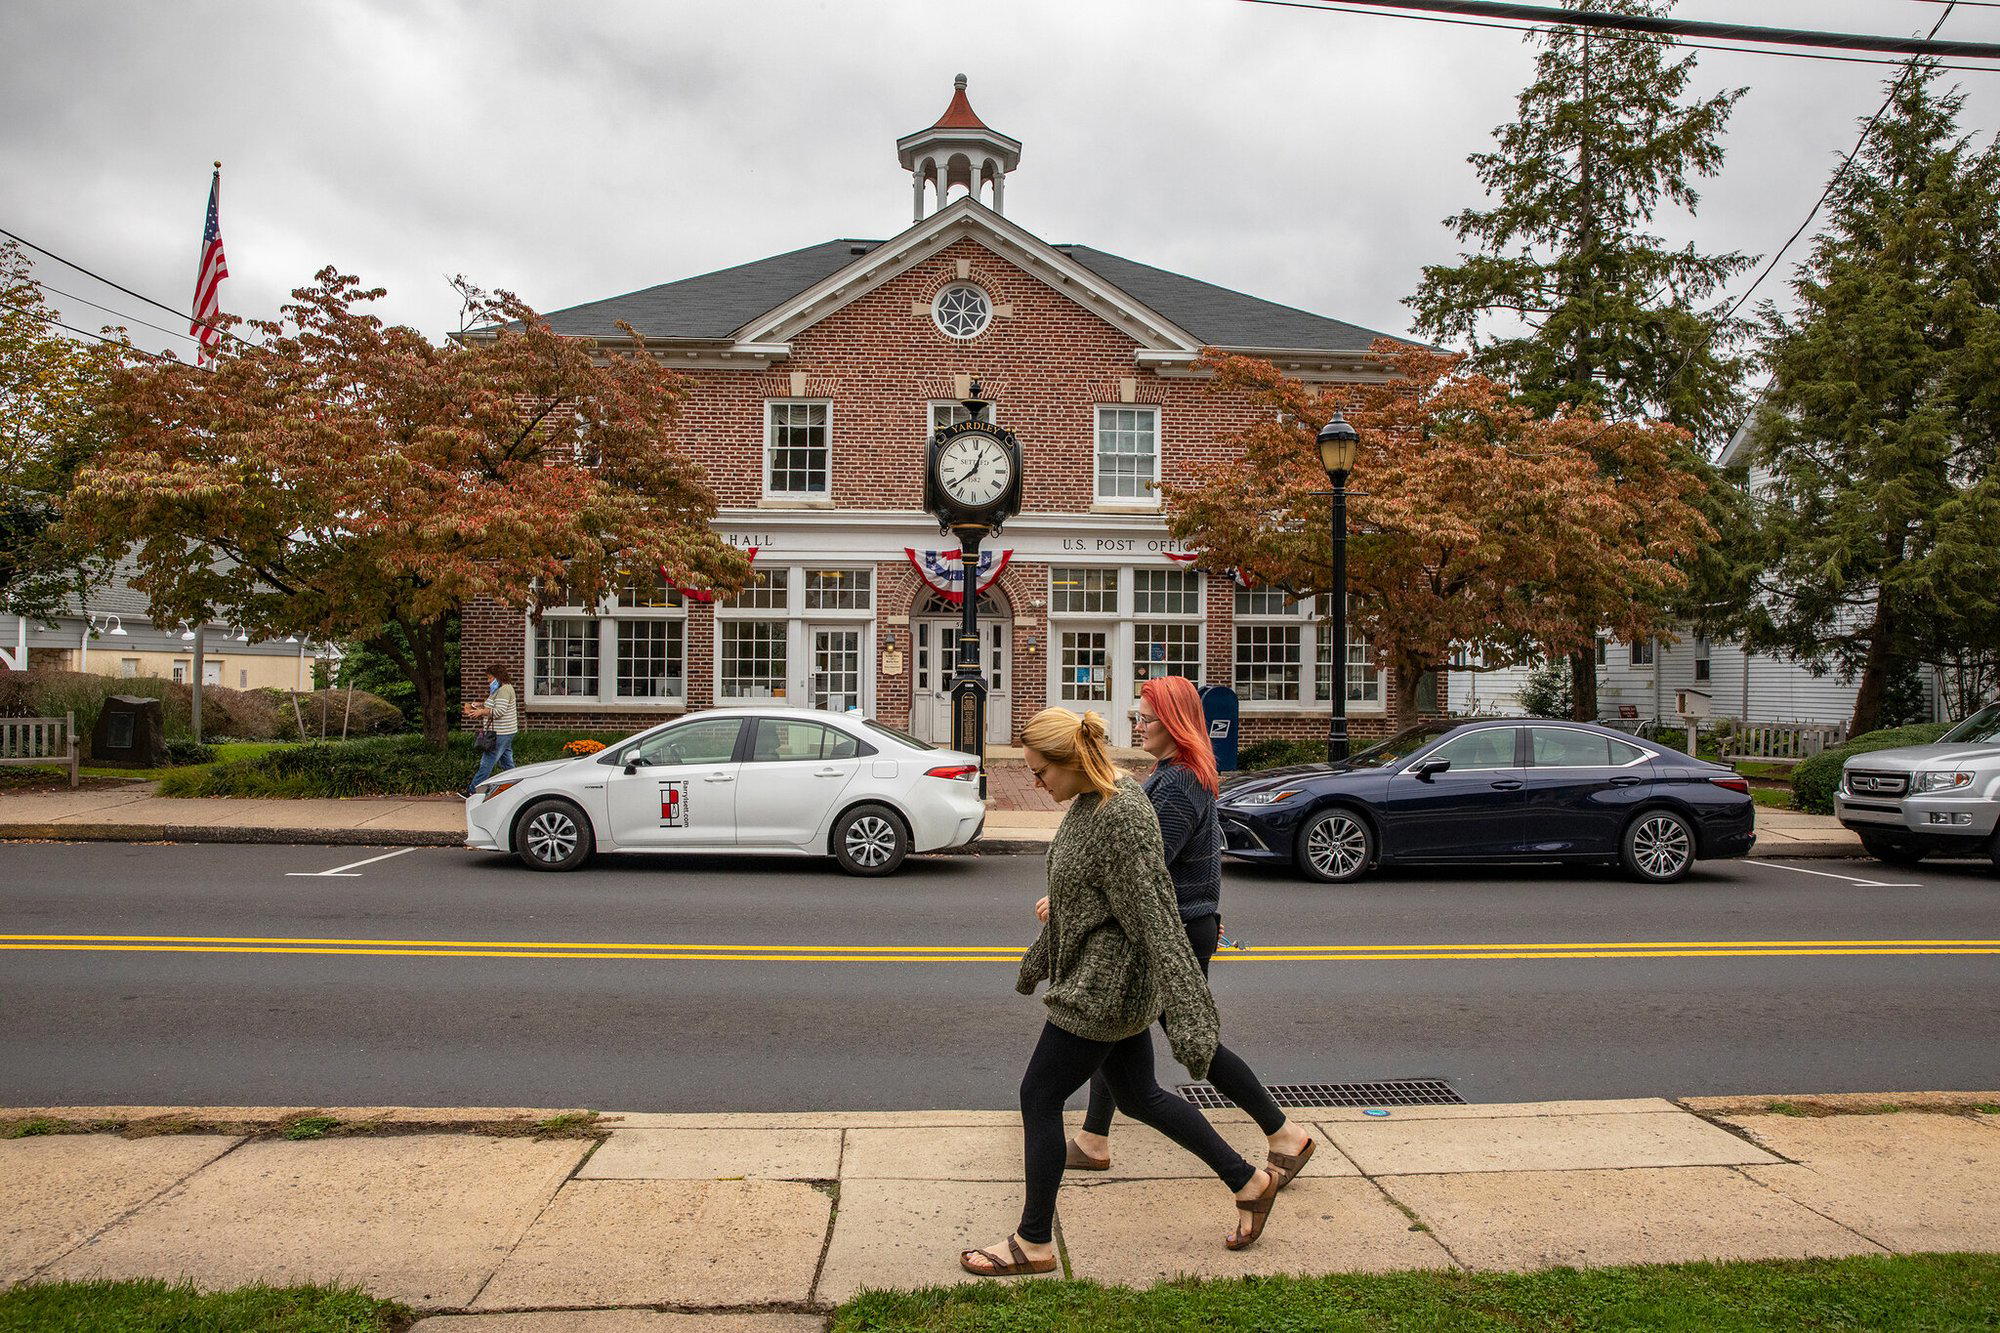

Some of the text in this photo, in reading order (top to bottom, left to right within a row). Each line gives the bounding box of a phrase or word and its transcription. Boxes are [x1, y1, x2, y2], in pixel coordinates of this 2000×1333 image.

[951, 421, 1000, 433] YARDLEY
[729, 534, 773, 546] HALL
[1063, 539, 1198, 552] U.S. POST OFFIC
